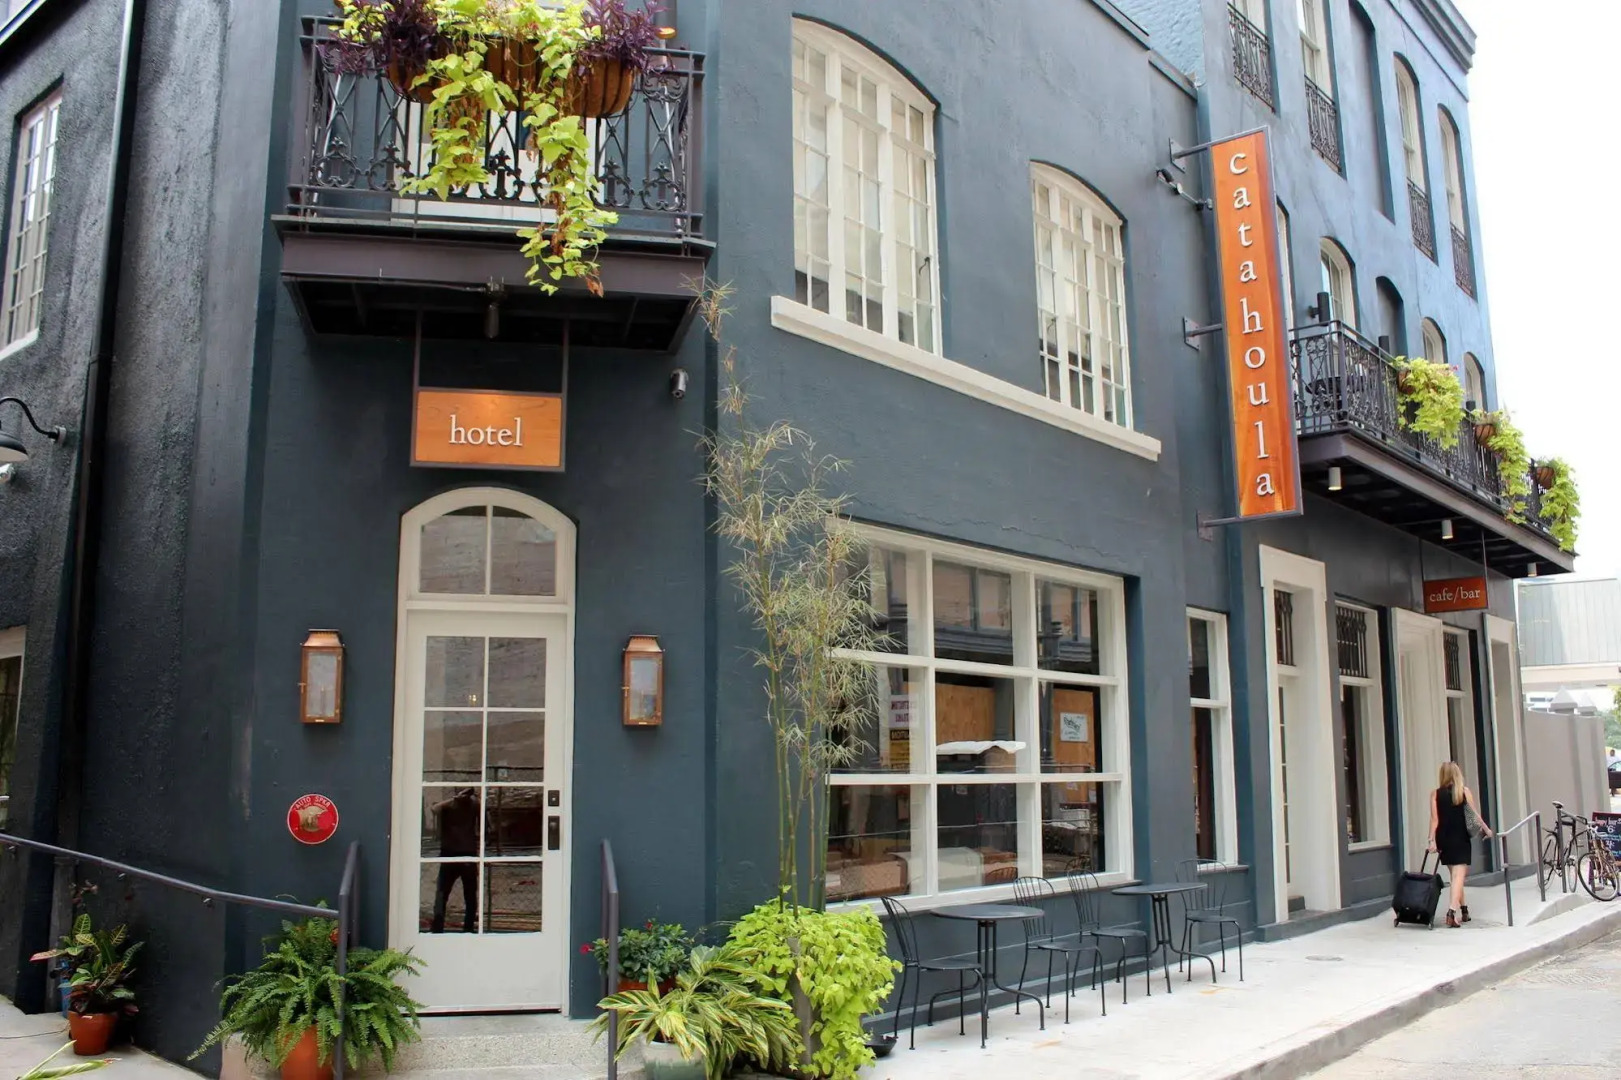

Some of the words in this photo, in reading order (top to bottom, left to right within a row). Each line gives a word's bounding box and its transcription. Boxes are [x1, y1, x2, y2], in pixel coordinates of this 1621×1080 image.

[1229, 151, 1275, 497] catahoula
[449, 414, 523, 446] hotel
[1429, 586, 1480, 604] cafe/bar
[295, 796, 311, 809] AUTO
